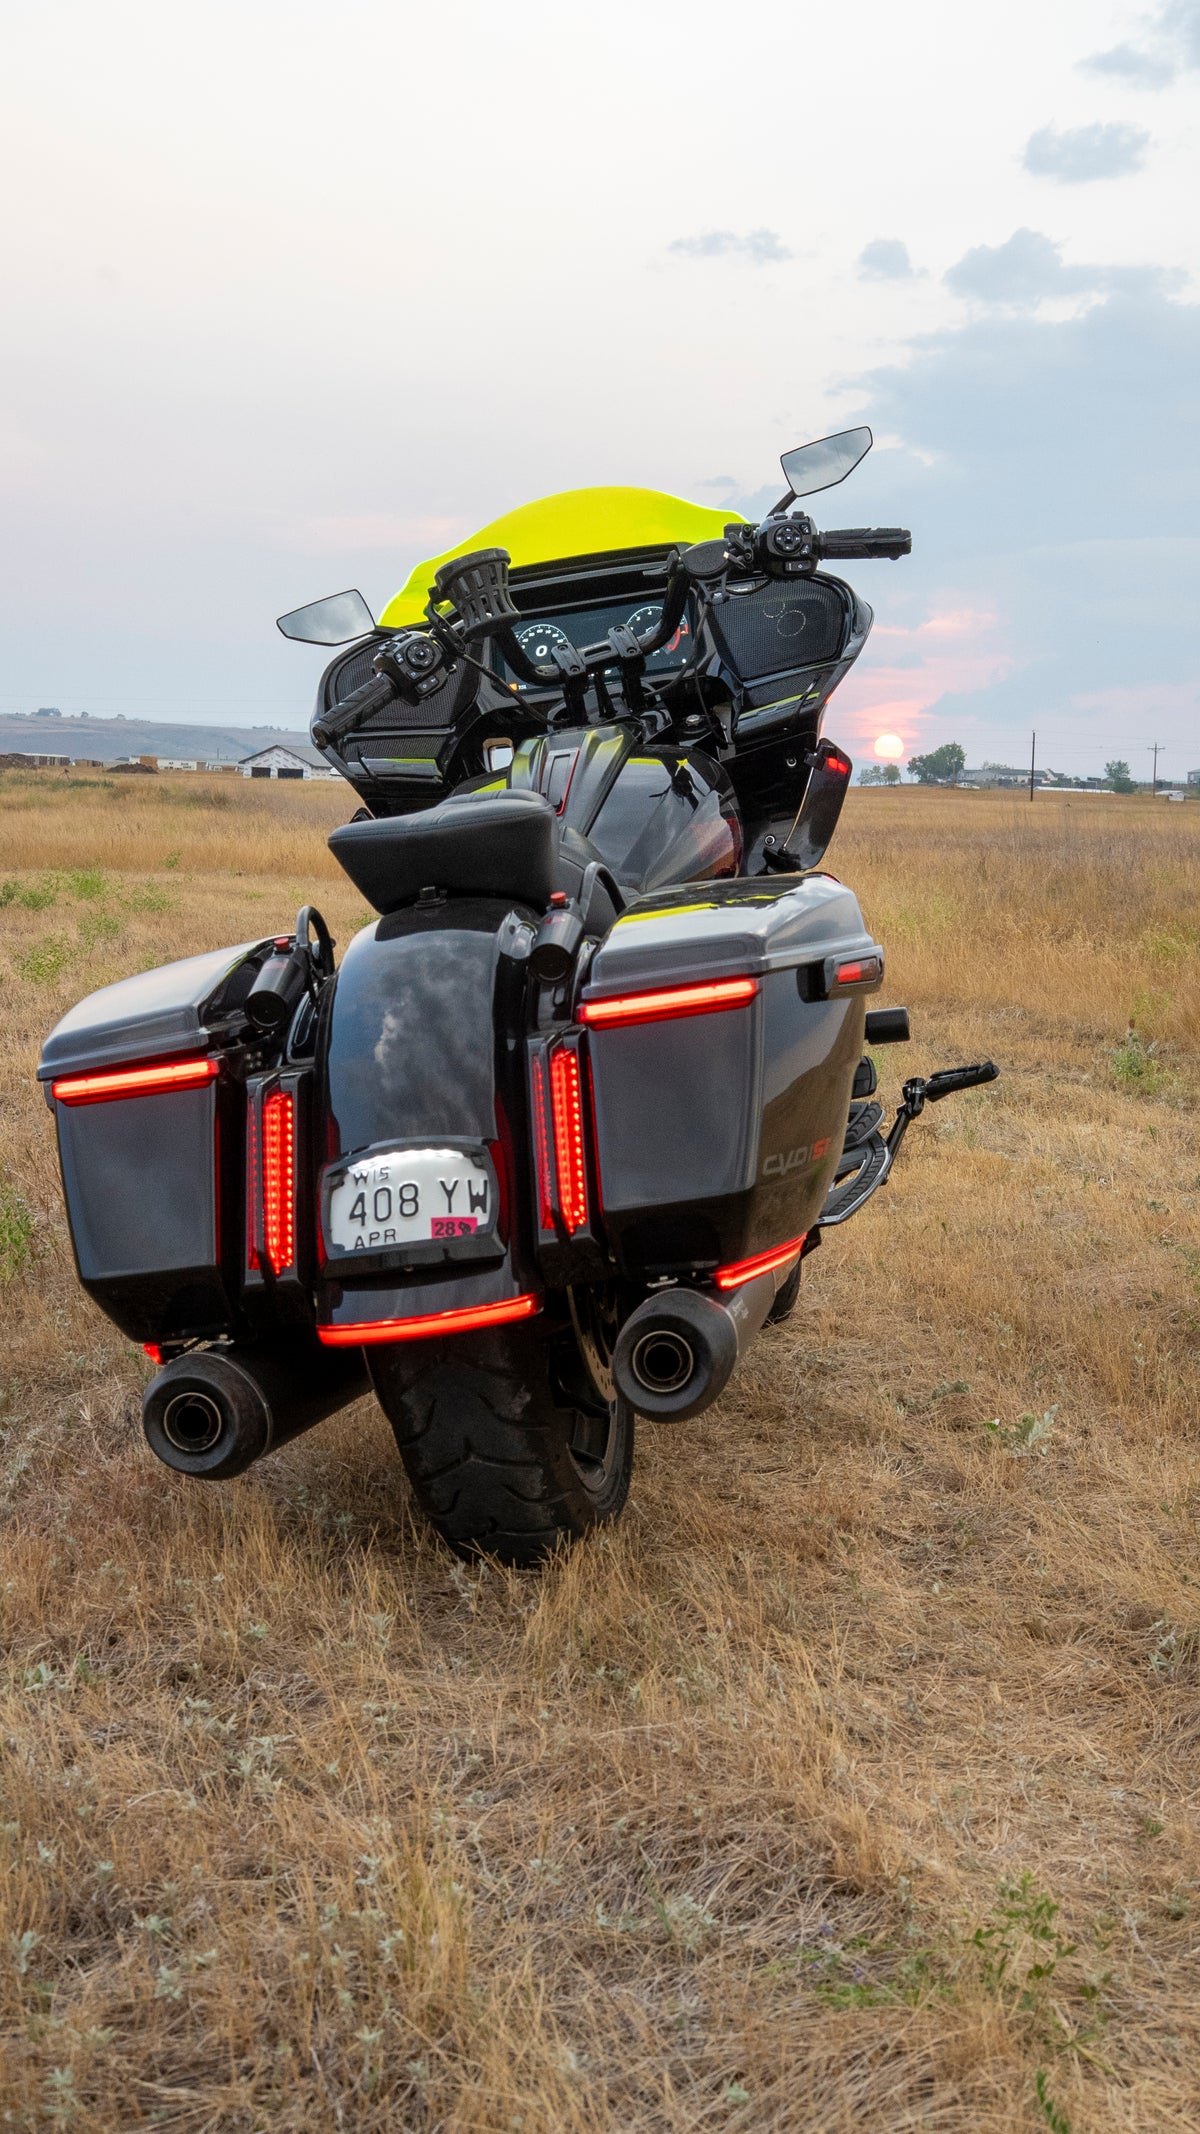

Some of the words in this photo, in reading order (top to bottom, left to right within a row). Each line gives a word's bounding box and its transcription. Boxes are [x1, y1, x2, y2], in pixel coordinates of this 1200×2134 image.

[535, 645, 548, 657] 0
[353, 1166, 392, 1186] WIS
[349, 1182, 419, 1227] 408
[439, 1179, 488, 1214] YW
[354, 1228, 397, 1250] APR
[434, 1221, 456, 1237] 28
